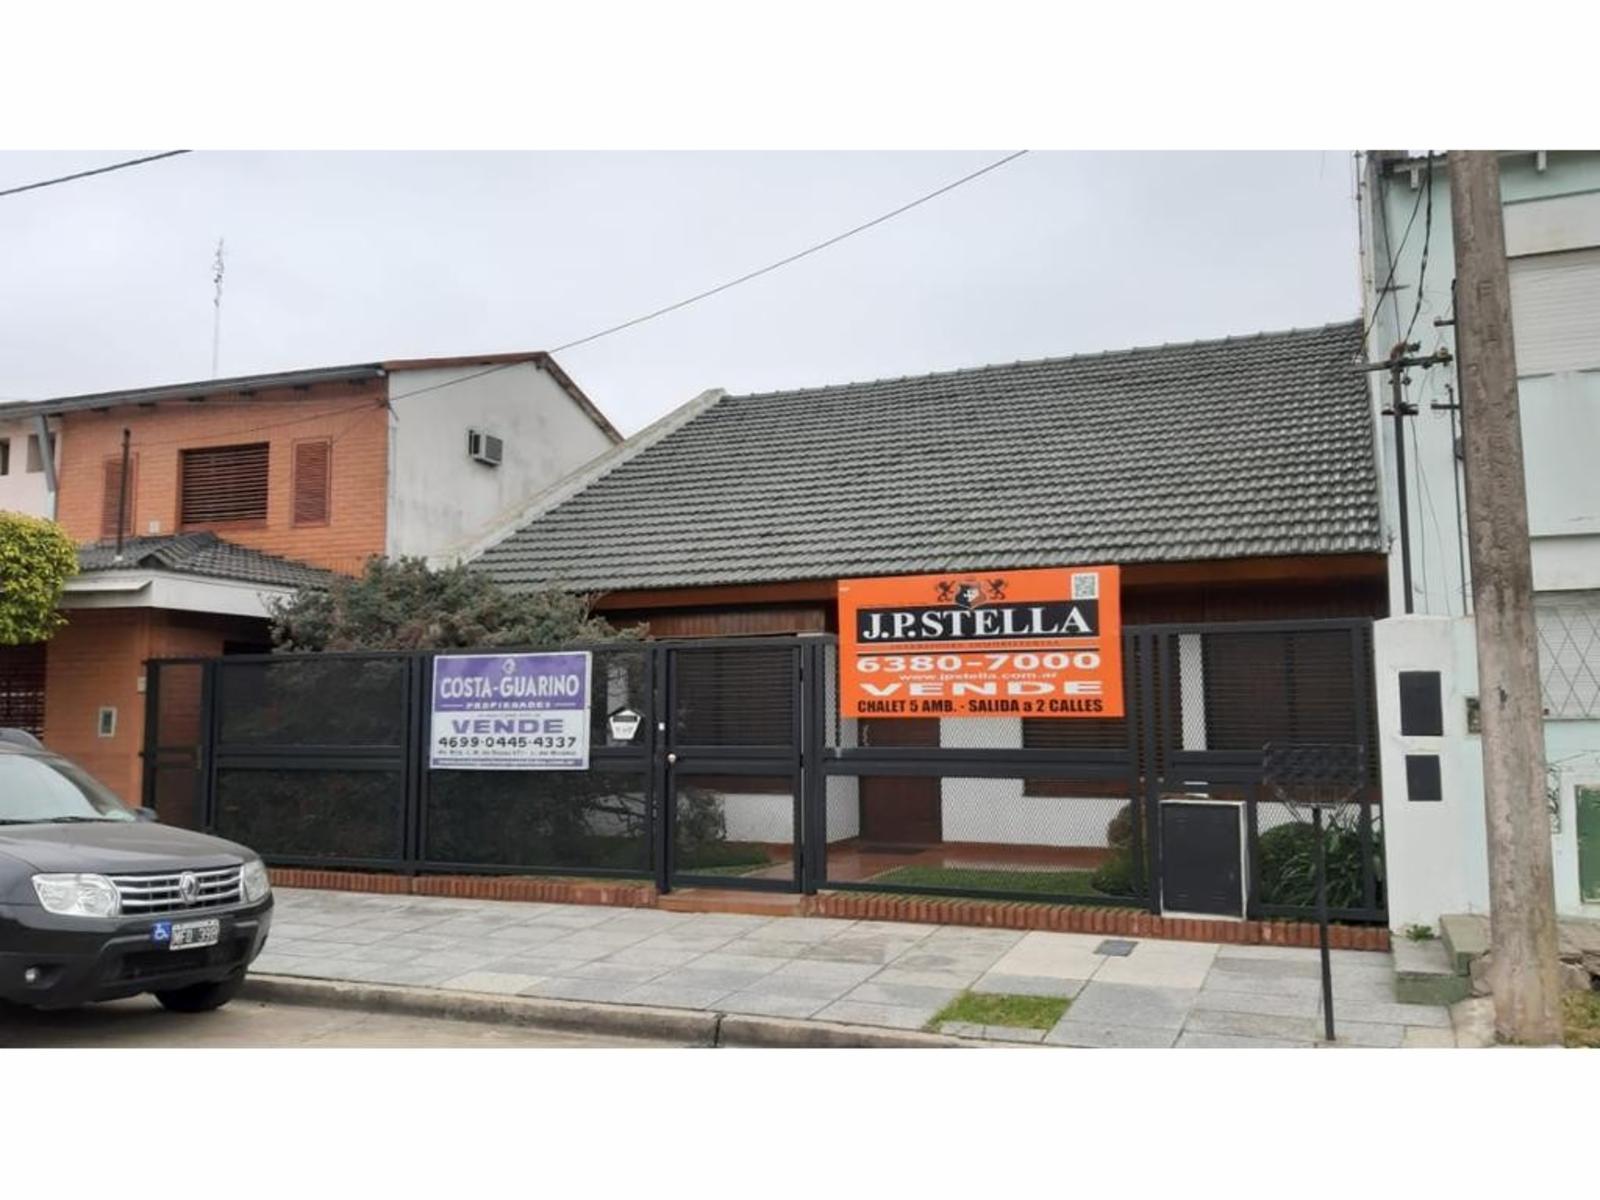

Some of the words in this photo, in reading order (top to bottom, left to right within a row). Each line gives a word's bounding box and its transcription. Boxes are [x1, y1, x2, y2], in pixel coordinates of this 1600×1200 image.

[856, 652, 1101, 673] 6380-7000
[859, 681, 1104, 697] VENDE
[857, 700, 907, 713] CHALET
[909, 700, 919, 712] 5
[921, 700, 958, 712] AMB.
[968, 699, 1019, 712] SALIDA
[1036, 699, 1045, 712] 2
[1048, 699, 1104, 712] CALLES
[452, 719, 564, 734] VENDE
